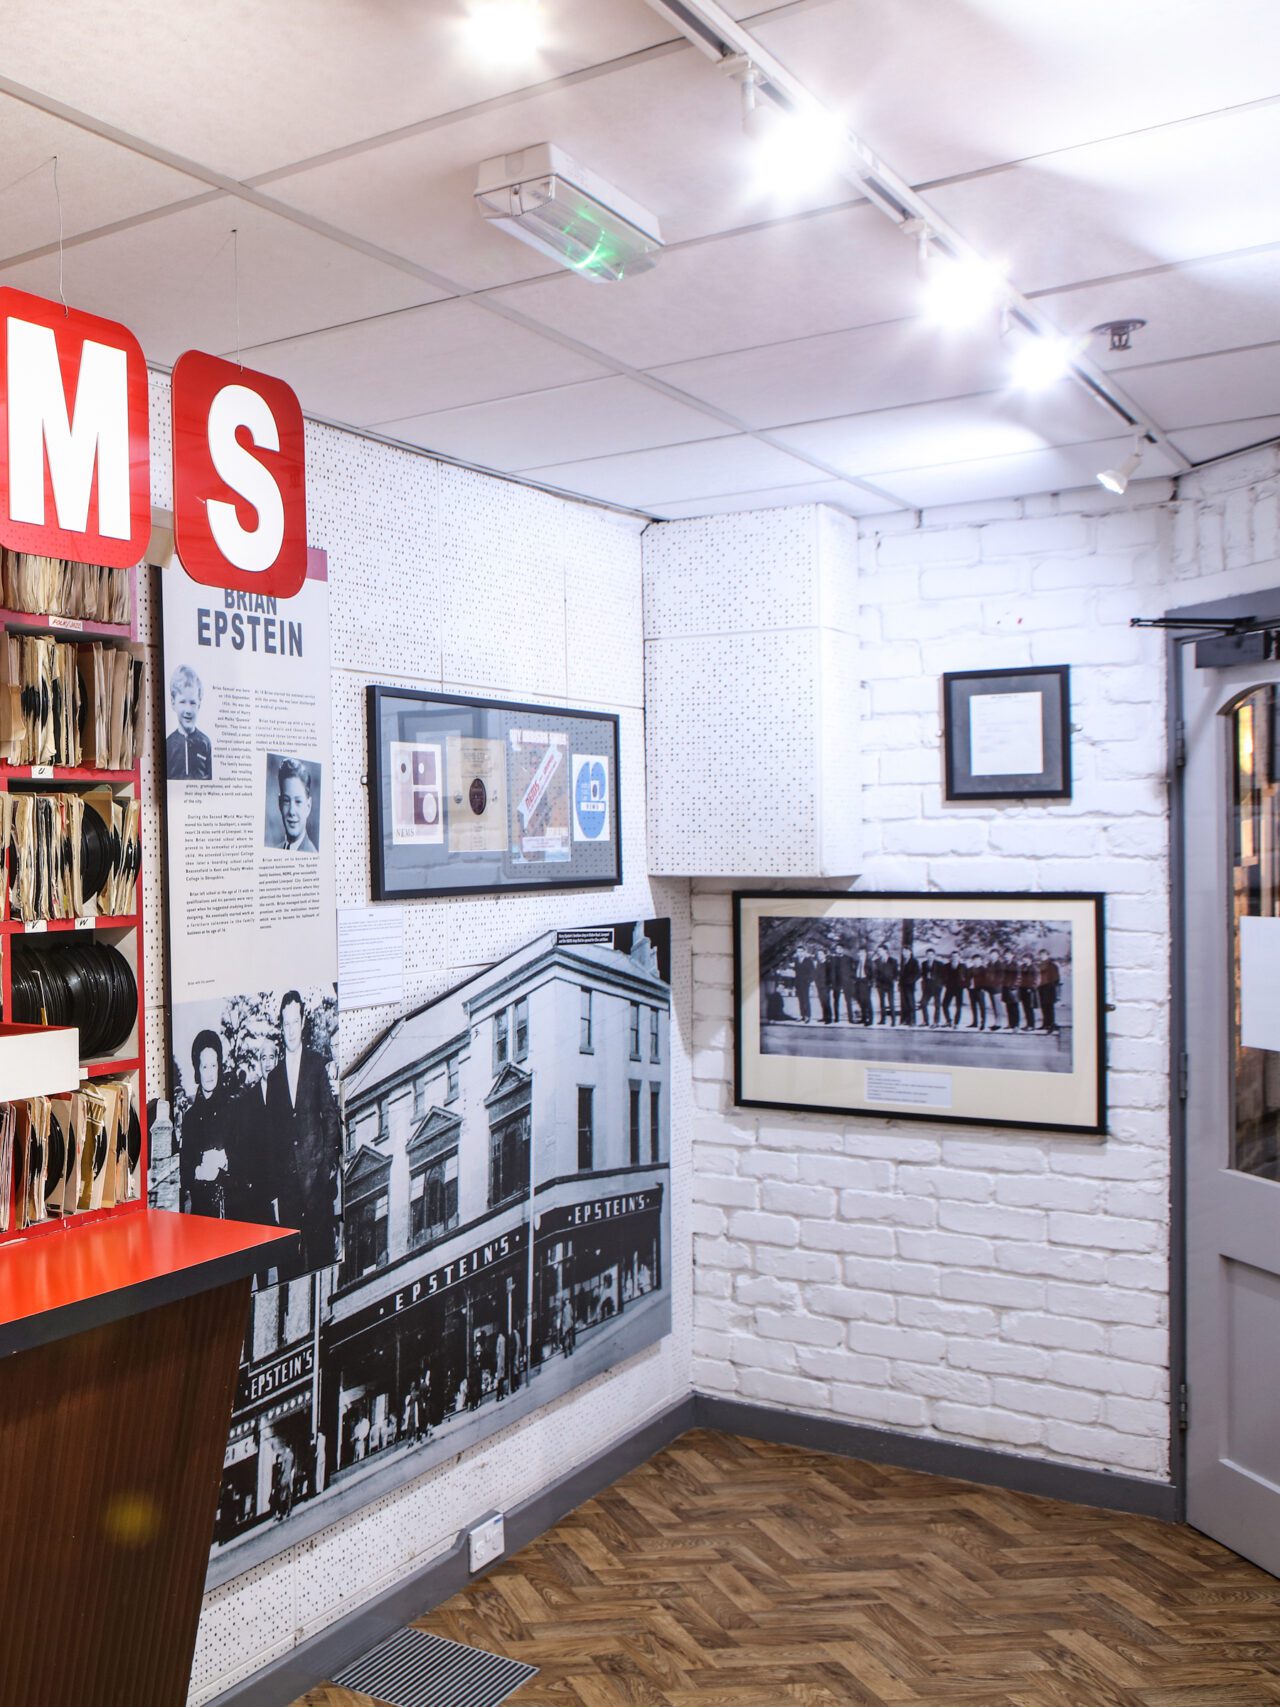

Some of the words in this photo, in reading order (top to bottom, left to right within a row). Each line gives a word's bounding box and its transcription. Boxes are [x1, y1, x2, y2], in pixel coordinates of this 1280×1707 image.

[224, 588, 277, 616] BRIAN
[197, 607, 303, 658] EPSTEIN
[575, 1194, 646, 1225] EPSTEIN'S
[394, 1235, 510, 1313] EPSTEIN'S
[251, 1349, 313, 1400] EPSTEIN'S
